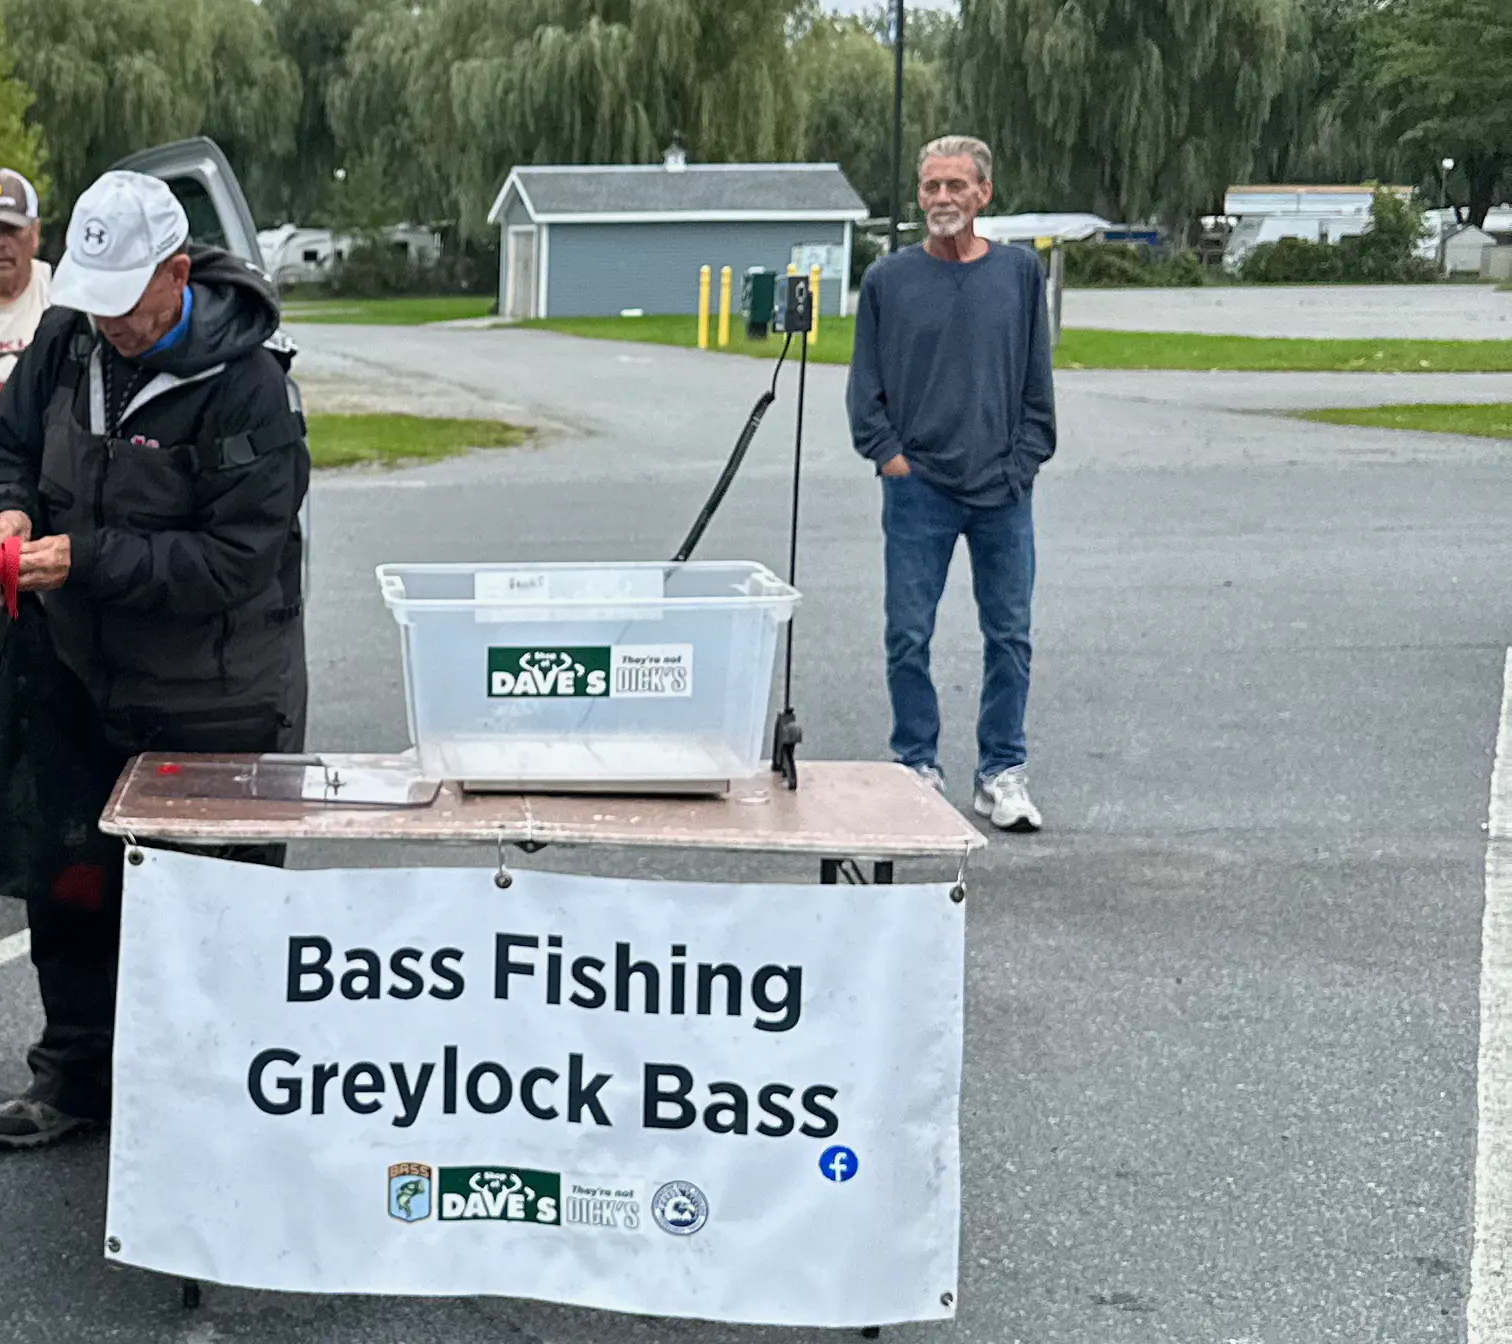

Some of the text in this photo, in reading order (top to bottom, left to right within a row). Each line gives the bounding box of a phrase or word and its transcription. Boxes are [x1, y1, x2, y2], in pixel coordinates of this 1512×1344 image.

[621, 654, 660, 665] They're
[491, 663, 608, 696] DAVE'S
[615, 666, 687, 694] DICK'S
[286, 932, 803, 1033] Bass Fishing
[247, 1045, 839, 1139] Greylock Bass
[390, 1163, 430, 1178] BASS
[441, 1187, 557, 1223] DAVE'S
[571, 1184, 611, 1197] They're
[566, 1195, 641, 1229] DICK'S
